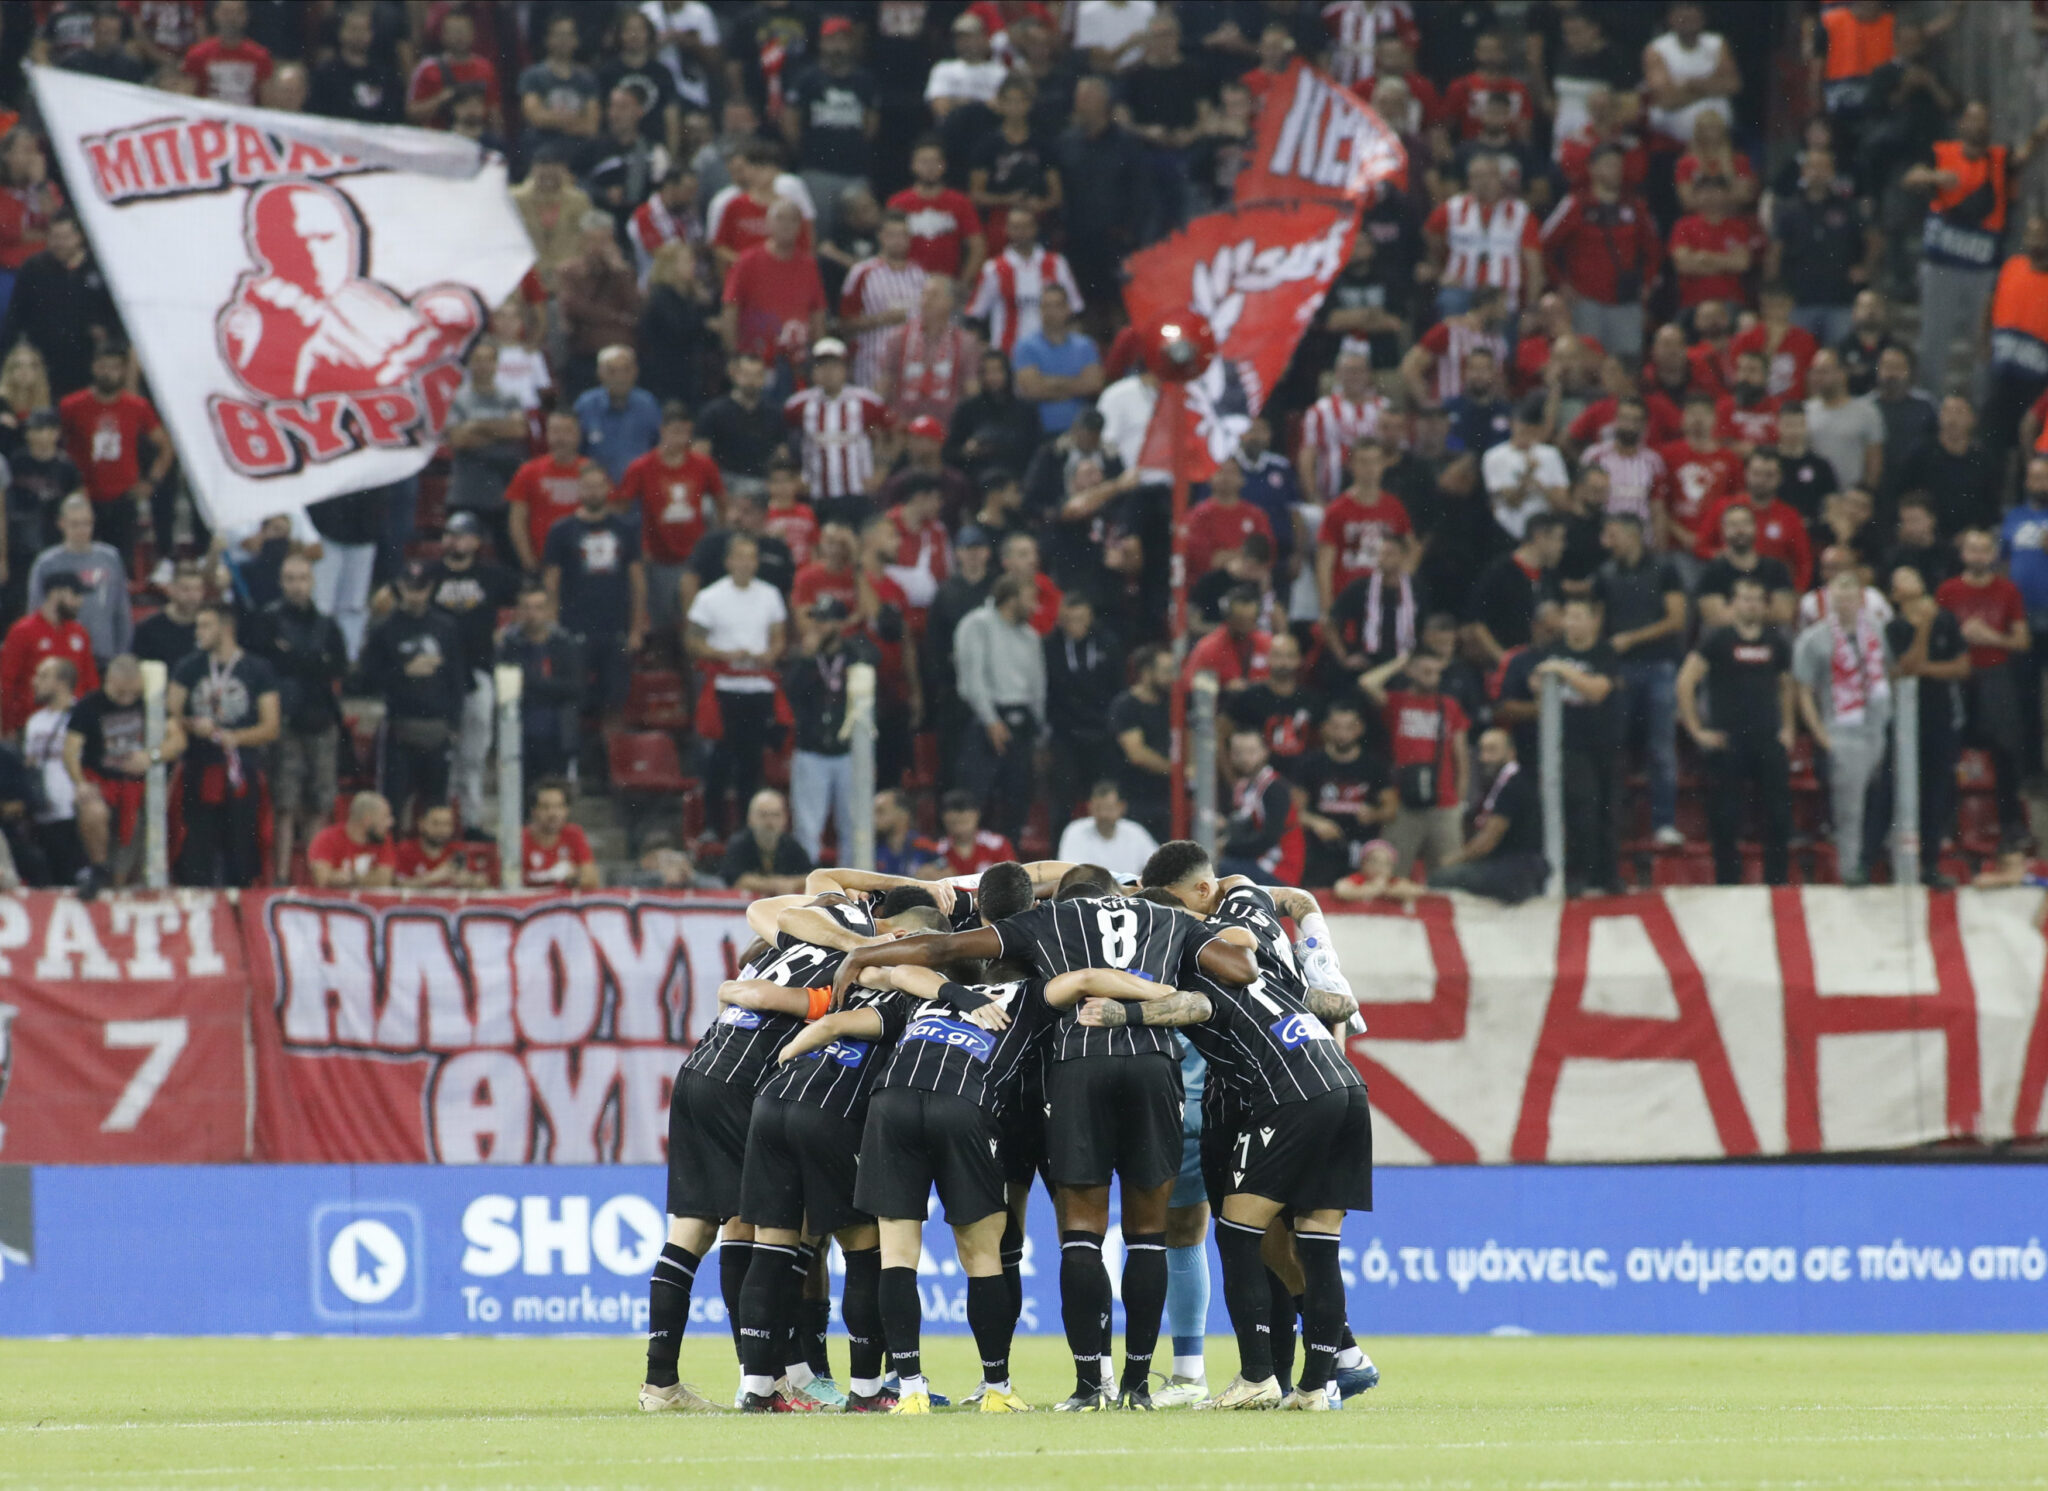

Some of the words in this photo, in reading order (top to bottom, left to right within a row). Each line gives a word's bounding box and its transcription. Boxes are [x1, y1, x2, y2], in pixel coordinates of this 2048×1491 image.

[1096, 906, 1138, 969] 8
[100, 1016, 190, 1133] 7
[1625, 1238, 1797, 1295] ανάμεσα
[1803, 1245, 1851, 1283] σε
[1856, 1237, 1964, 1282] πάνω
[1968, 1237, 2047, 1282] από
[511, 1283, 728, 1331] marketpce
